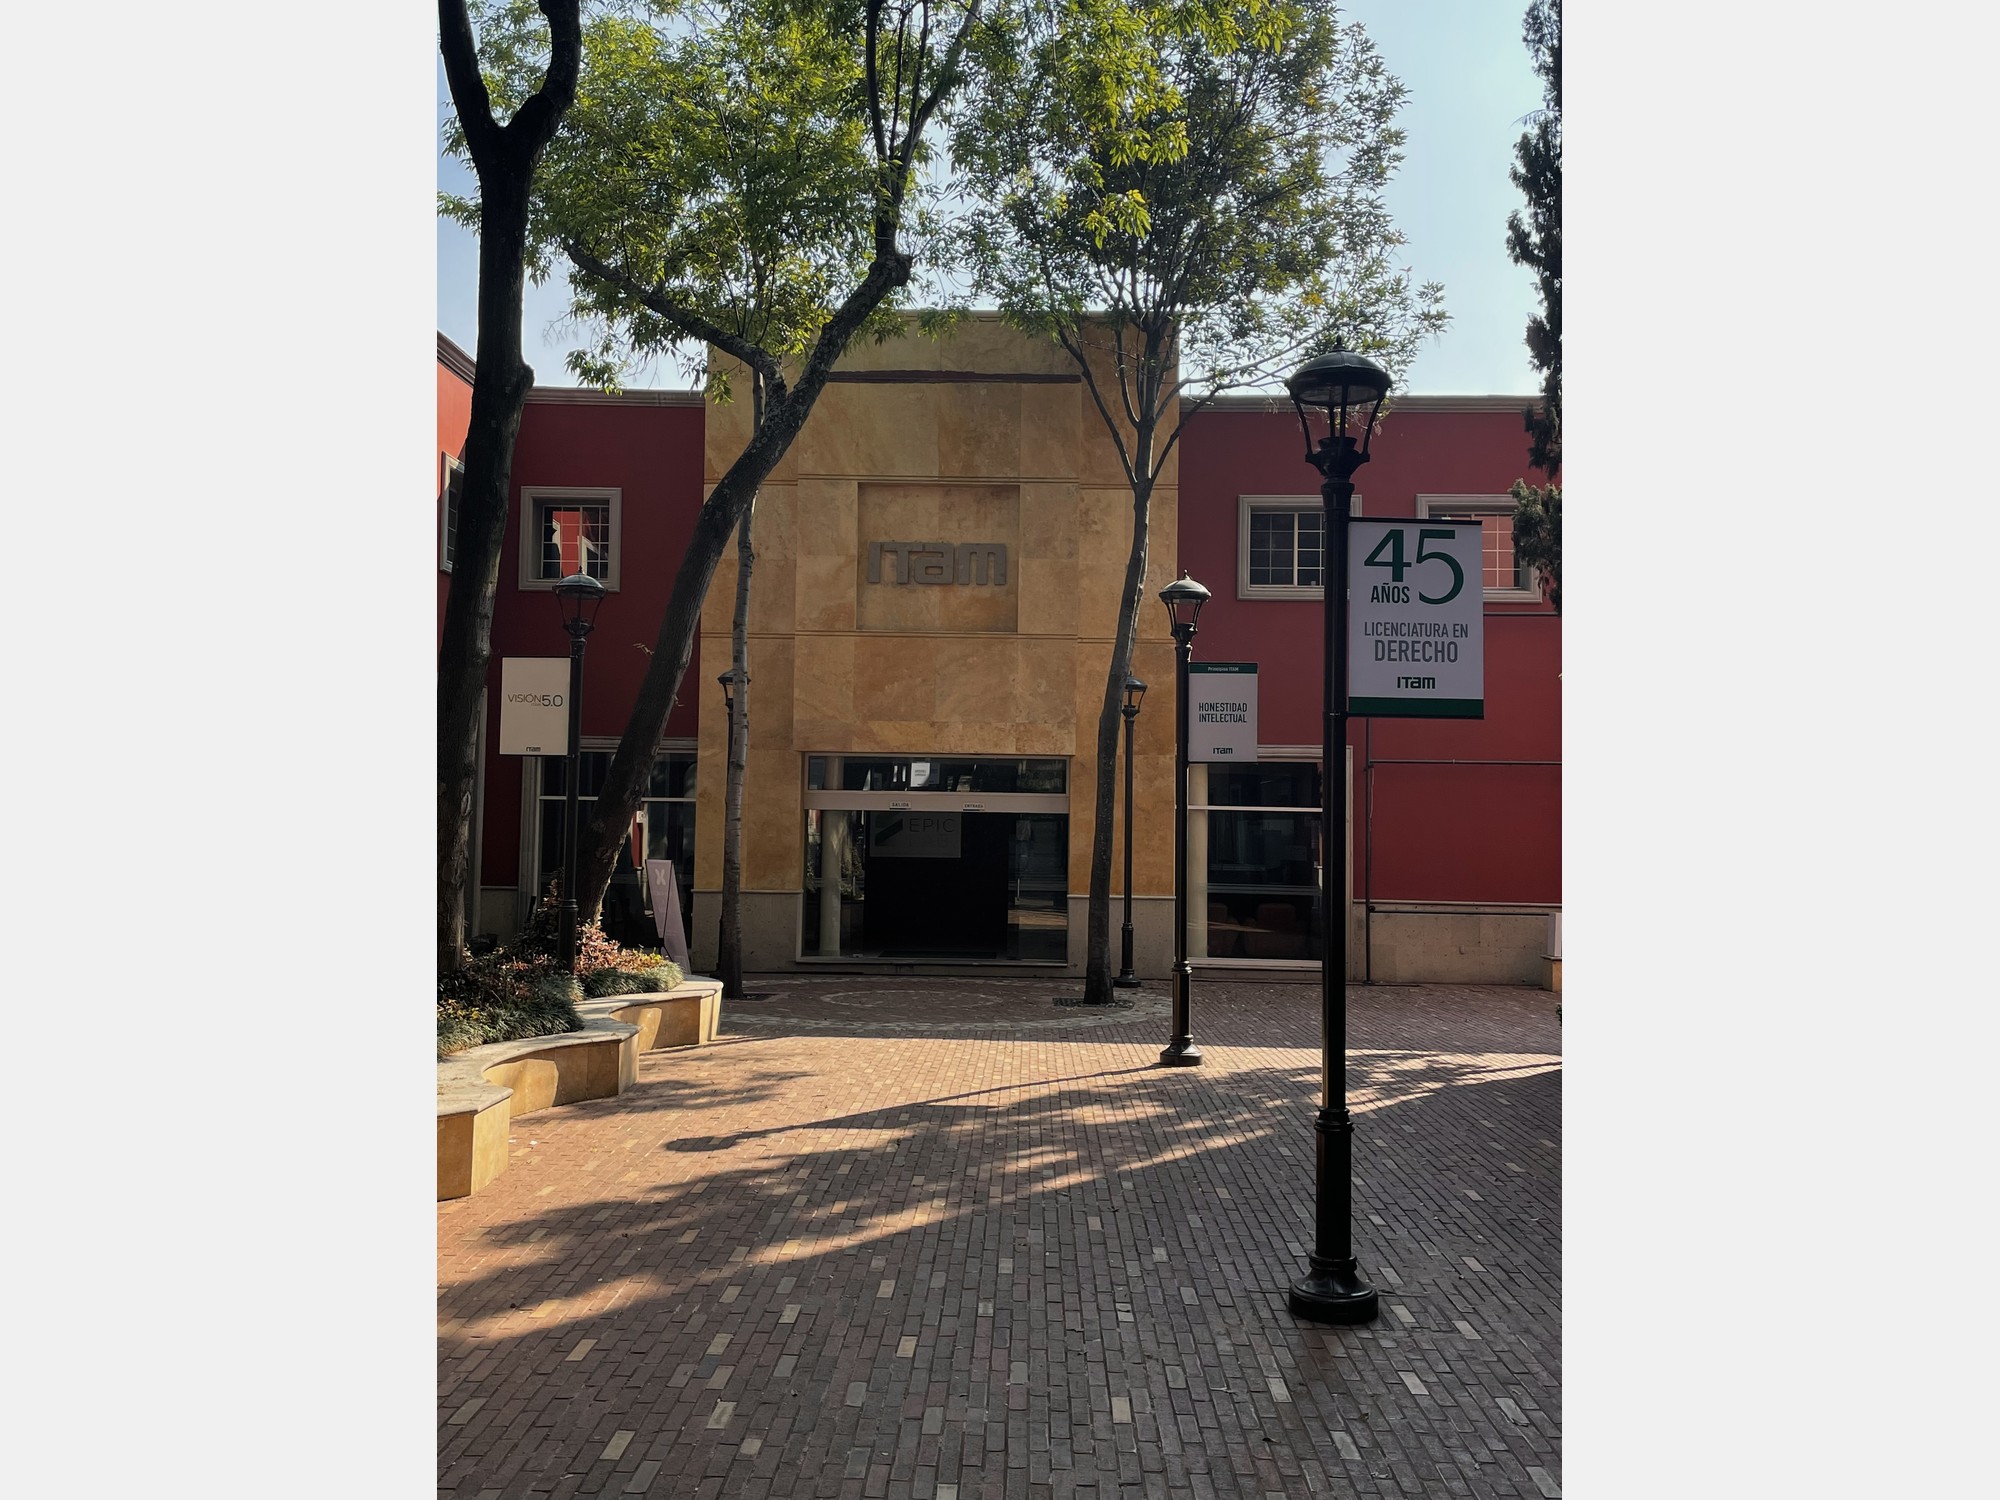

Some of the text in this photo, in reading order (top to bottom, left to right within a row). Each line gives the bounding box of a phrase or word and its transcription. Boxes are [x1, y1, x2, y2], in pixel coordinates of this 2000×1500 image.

[1364, 529, 1464, 605] 45
[1371, 583, 1410, 604] AÑOS
[1364, 622, 1468, 638] LICENCIATURA EN
[1375, 640, 1458, 663] DERECHO
[1199, 703, 1247, 712] HONESTIDAD
[1199, 713, 1247, 723] INTELECTUAL
[909, 819, 956, 833] EPIC
